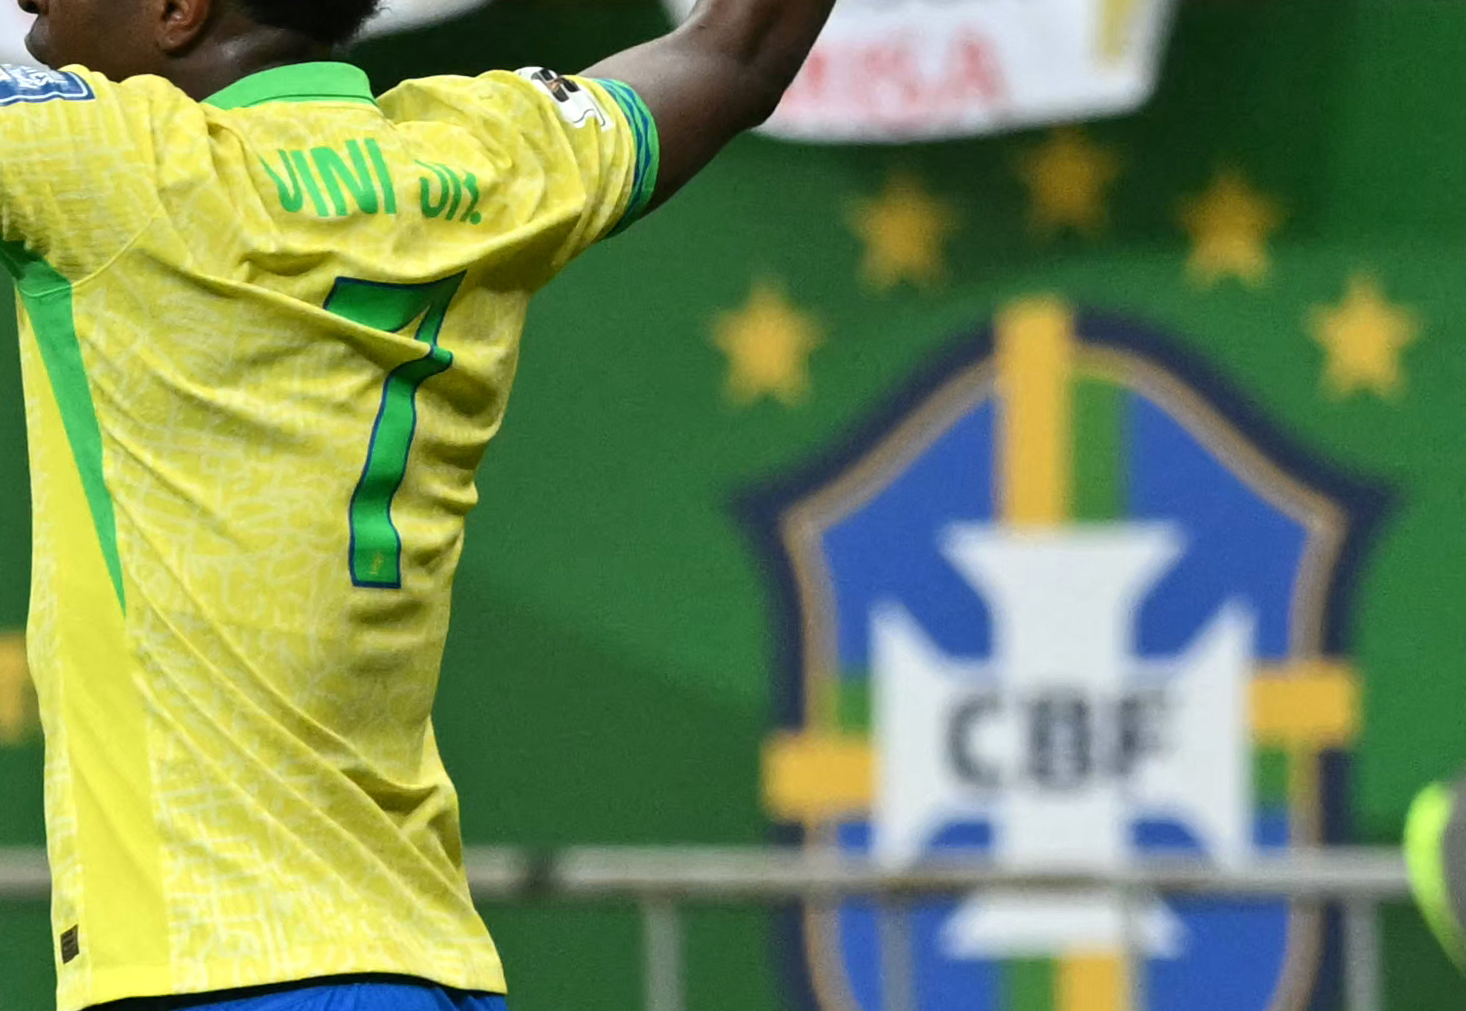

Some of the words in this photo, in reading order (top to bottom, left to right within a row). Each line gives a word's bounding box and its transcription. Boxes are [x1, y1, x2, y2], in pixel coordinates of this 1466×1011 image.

[774, 26, 1006, 112] MISA
[258, 138, 397, 217] VINI
[323, 269, 467, 589] 7
[945, 682, 1176, 794] CBF
